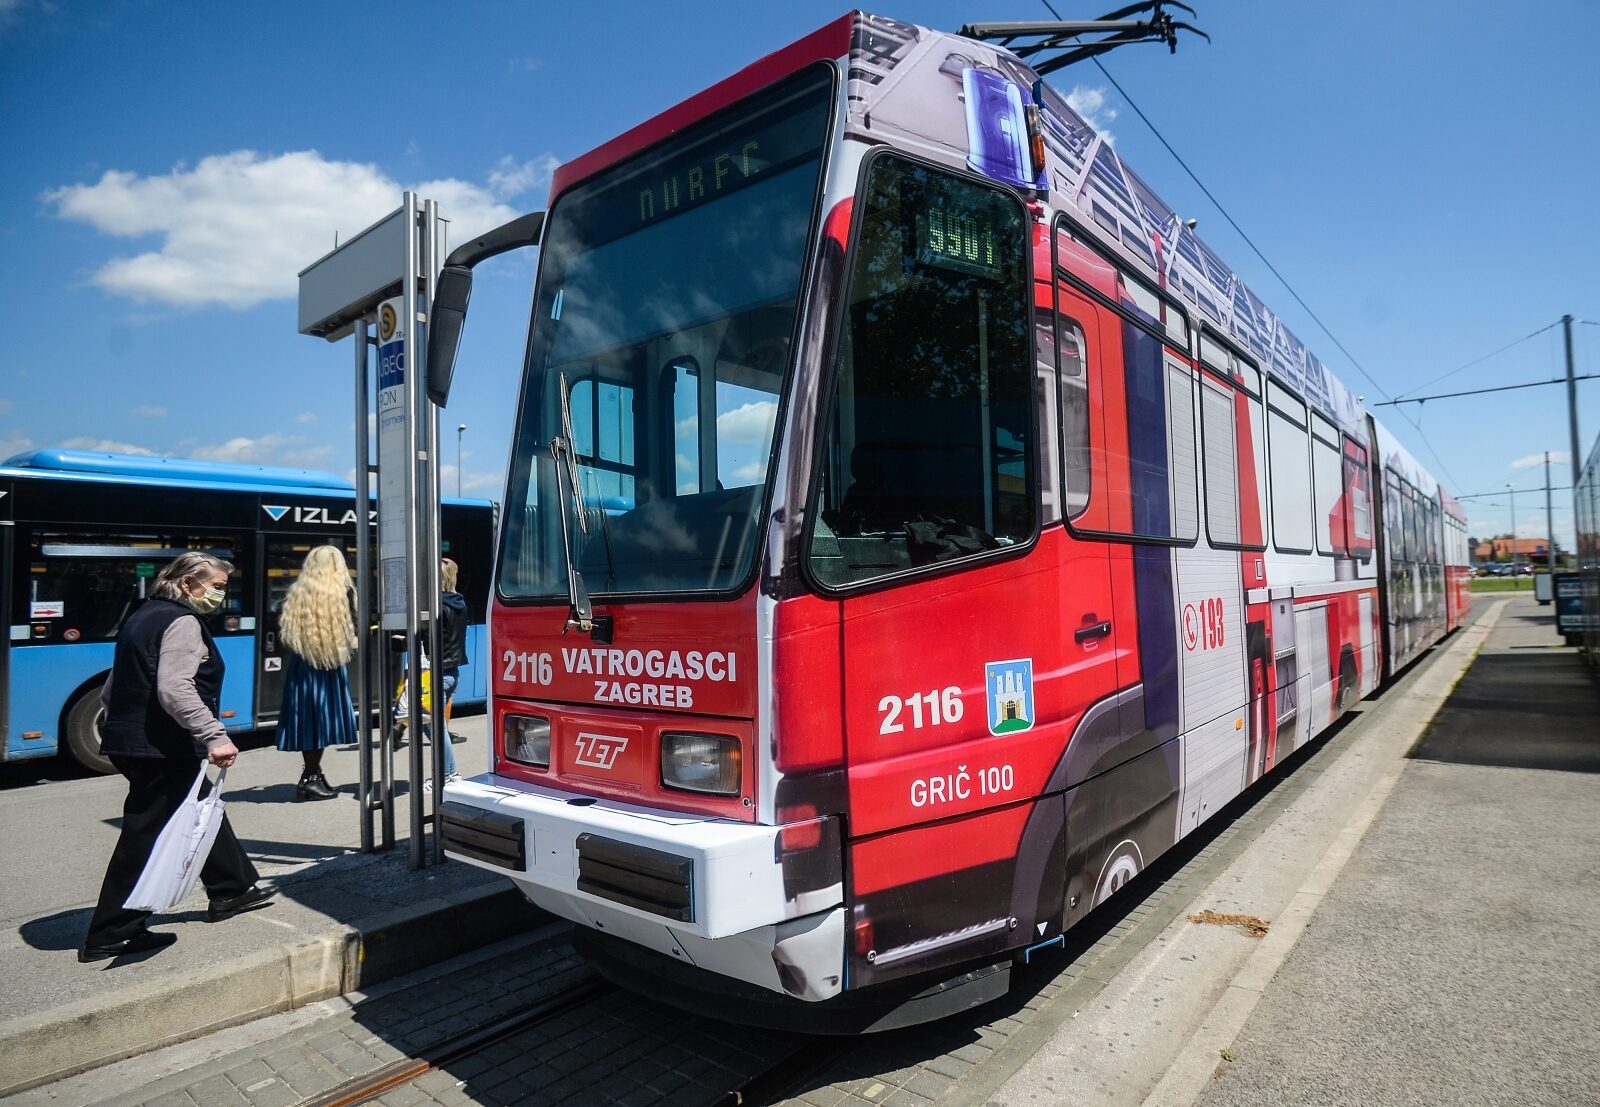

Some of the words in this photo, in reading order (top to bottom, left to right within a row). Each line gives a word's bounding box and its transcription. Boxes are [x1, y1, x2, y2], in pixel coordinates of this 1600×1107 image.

[1199, 597, 1224, 650] 193
[503, 650, 553, 686] 2116
[561, 647, 736, 682] VATROGASCI
[594, 680, 693, 708] ZAGREB
[878, 686, 964, 735] 2116
[910, 764, 971, 807] GRIČ
[979, 764, 1014, 795] 100
